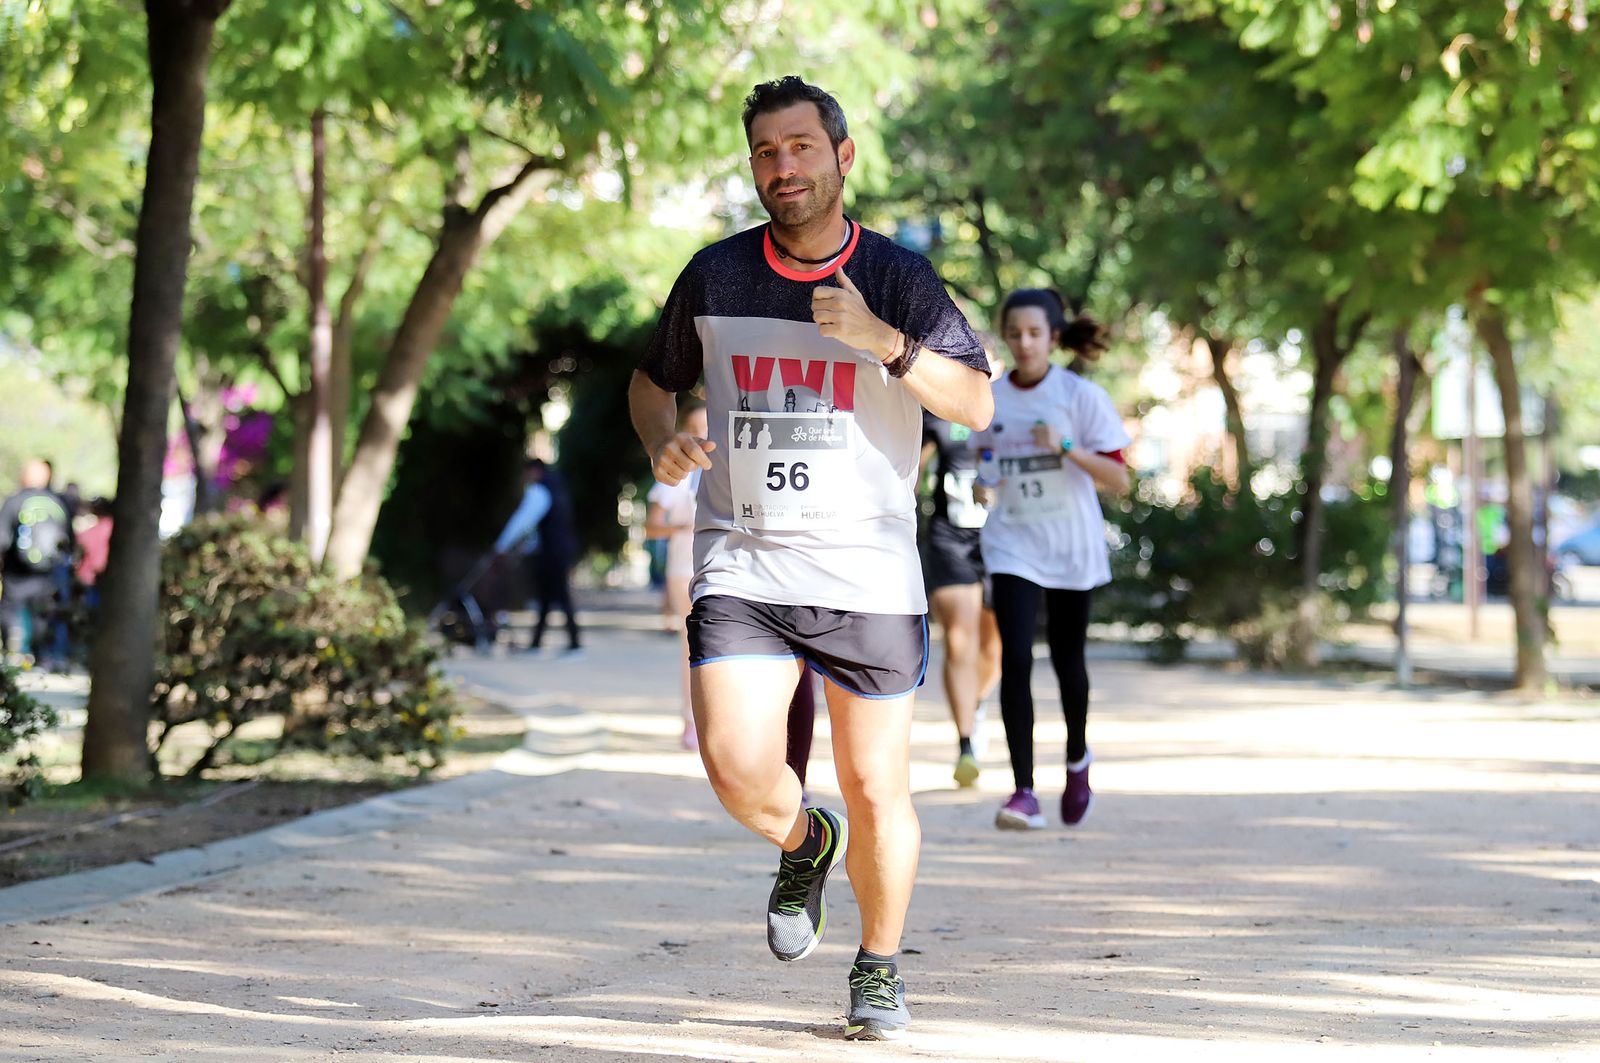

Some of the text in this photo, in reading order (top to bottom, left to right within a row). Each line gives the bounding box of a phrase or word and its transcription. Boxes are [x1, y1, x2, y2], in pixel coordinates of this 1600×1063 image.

[766, 462, 810, 491] 56
[1019, 479, 1043, 498] 13
[801, 511, 838, 520] HUELVA
